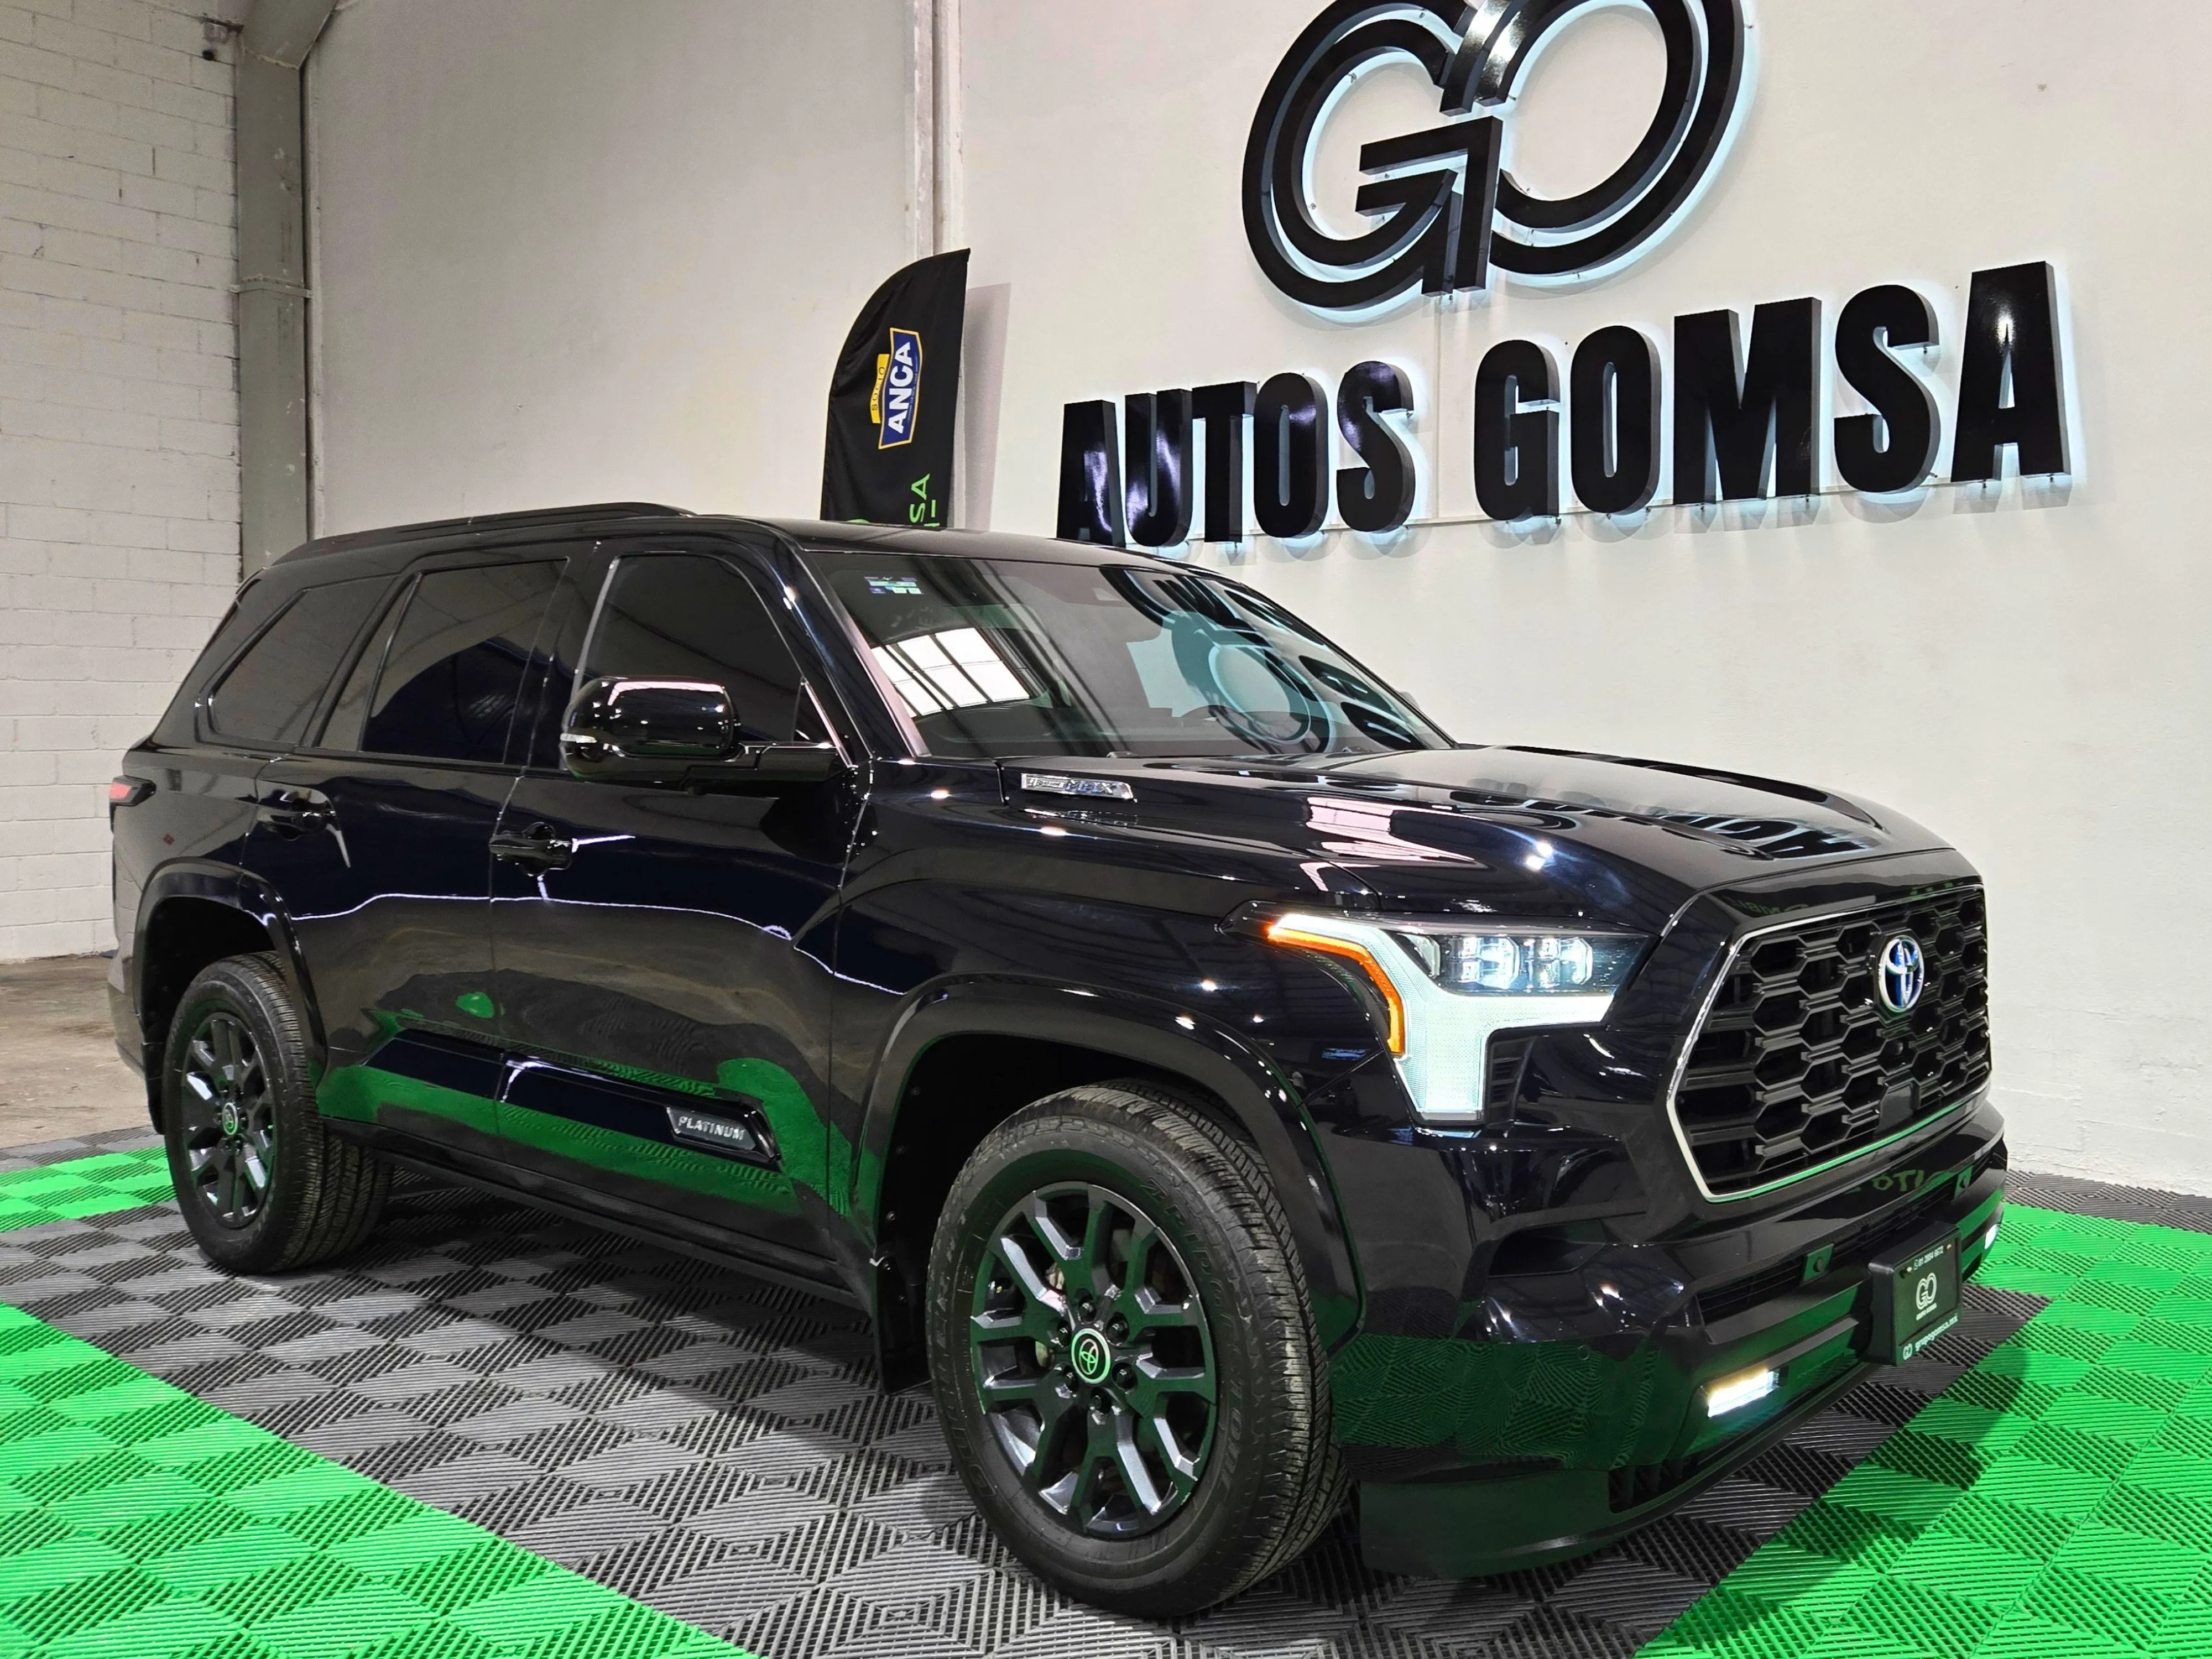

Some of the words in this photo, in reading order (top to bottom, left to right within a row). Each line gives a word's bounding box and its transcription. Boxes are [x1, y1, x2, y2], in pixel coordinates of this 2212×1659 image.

[888, 341, 913, 434] ANCA
[1057, 361, 1413, 545] AUTOS
[1474, 261, 2071, 522] GOMSA
[678, 1115, 745, 1141] PLATINUM
